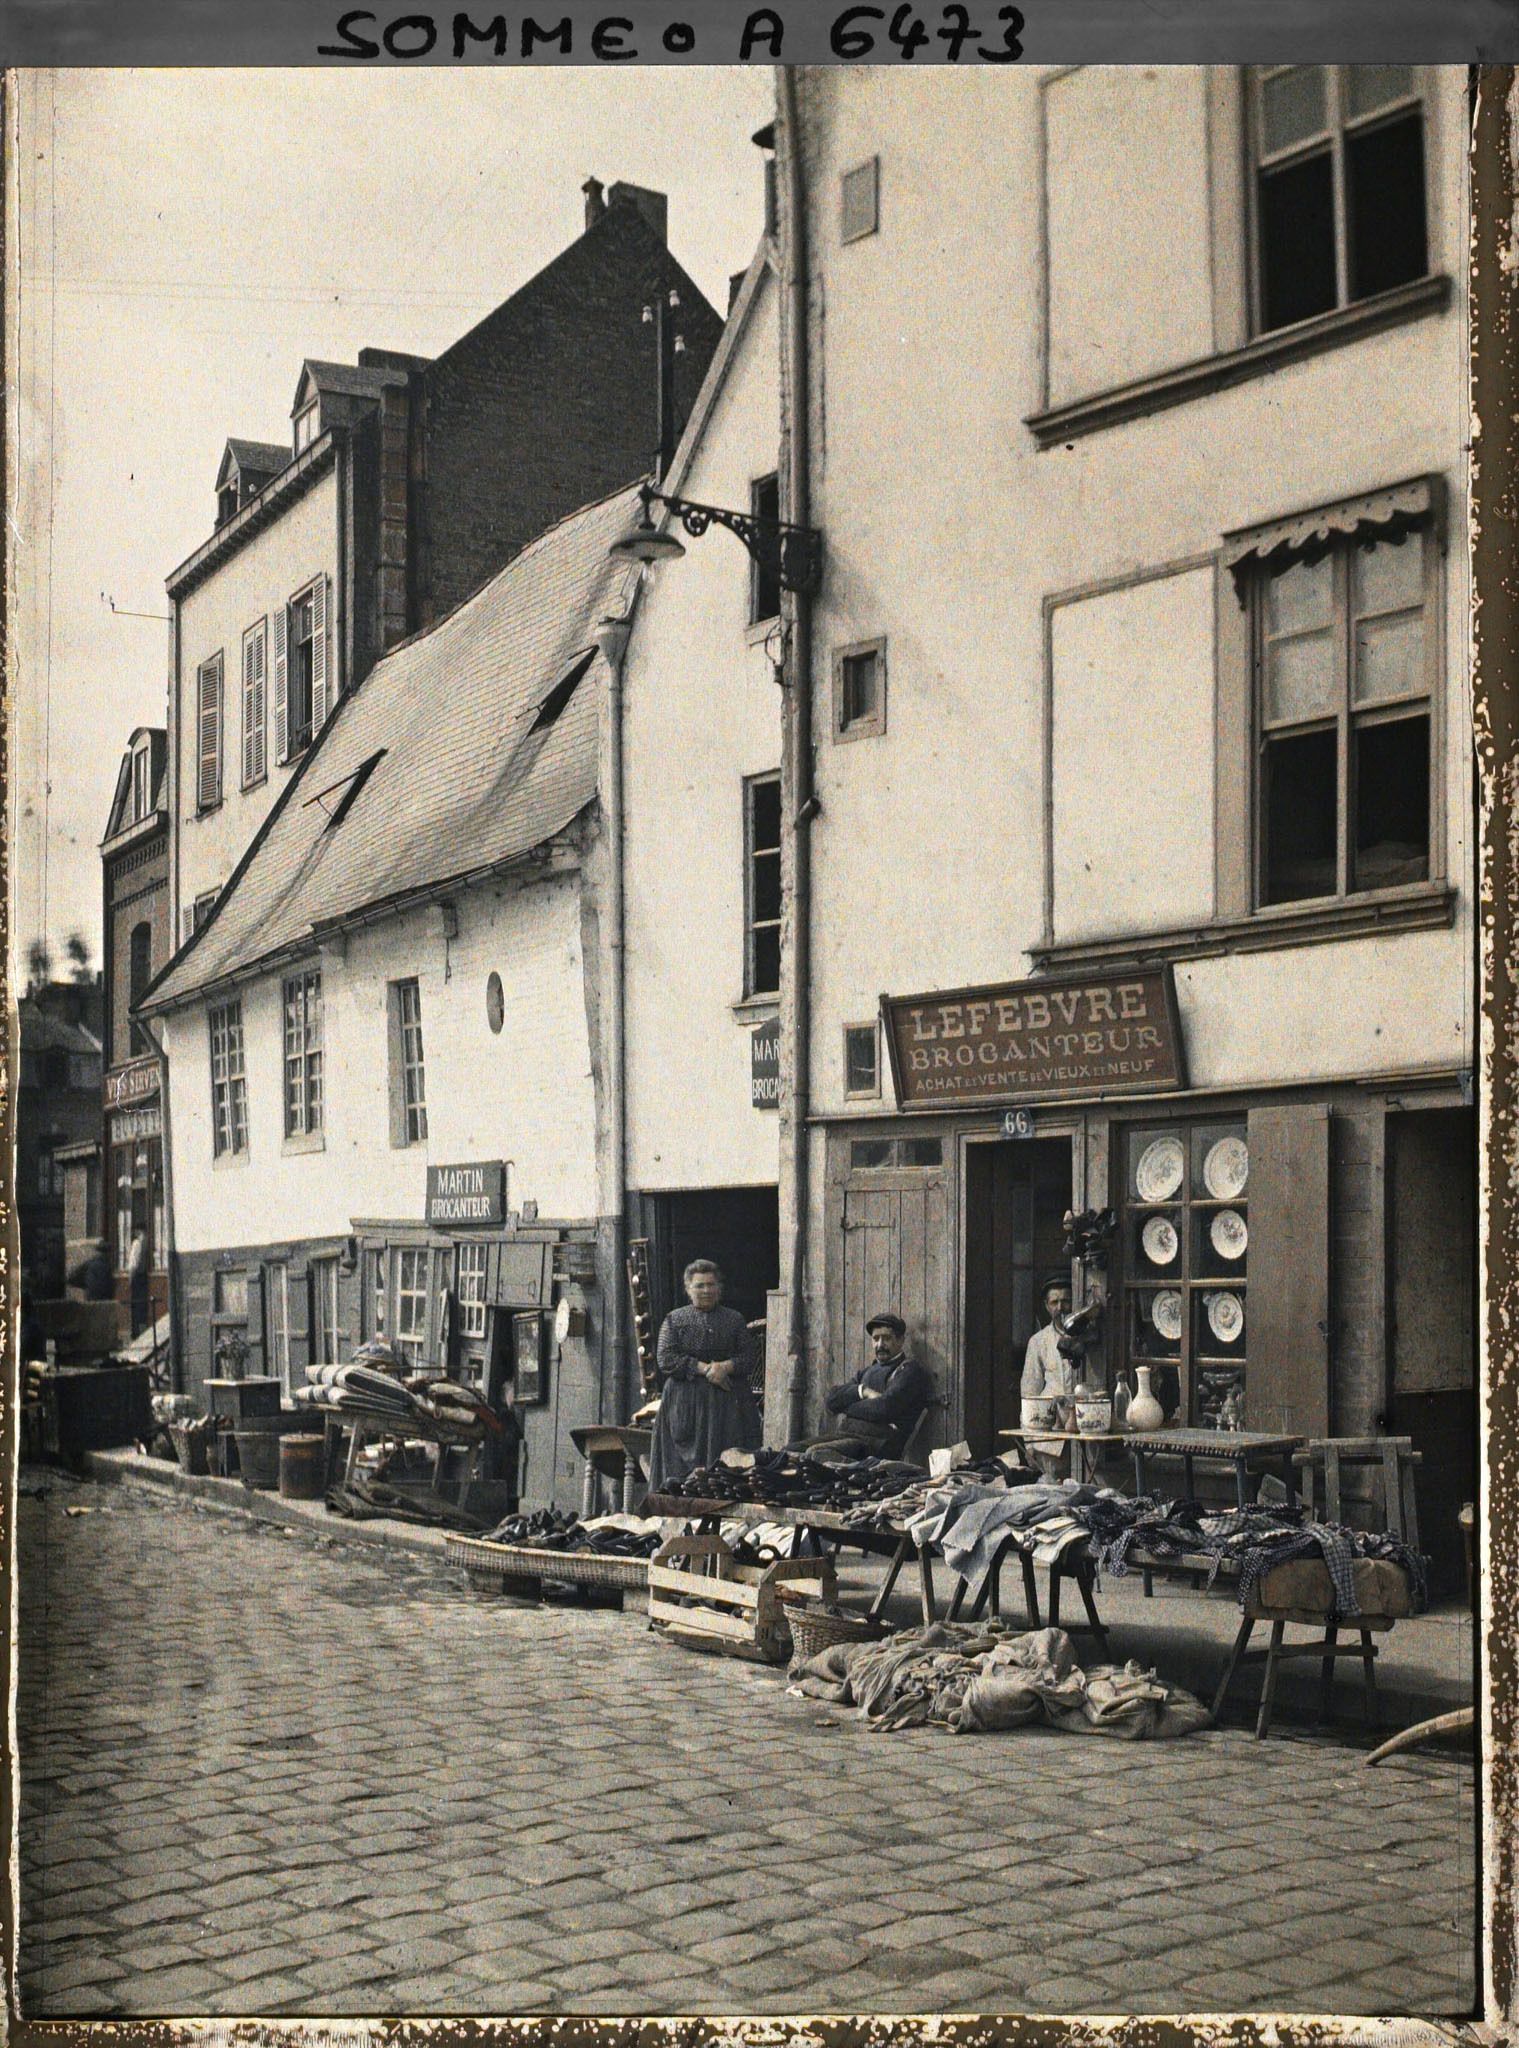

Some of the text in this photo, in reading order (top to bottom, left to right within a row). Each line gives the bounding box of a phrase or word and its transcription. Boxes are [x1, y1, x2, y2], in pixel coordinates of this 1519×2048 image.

[911, 983, 1148, 1041] LEFEBVRE
[911, 1026, 1163, 1071] BROCANTEUR
[916, 1076, 962, 1091] ACHAT
[978, 1071, 1028, 1086] VENTE
[1042, 1065, 1091, 1080] VIEUX
[1108, 1059, 1155, 1075] NEUF
[1005, 1111, 1028, 1134] 66
[437, 1168, 484, 1195] MARTIN
[431, 1197, 491, 1218] BROCANTEUR
